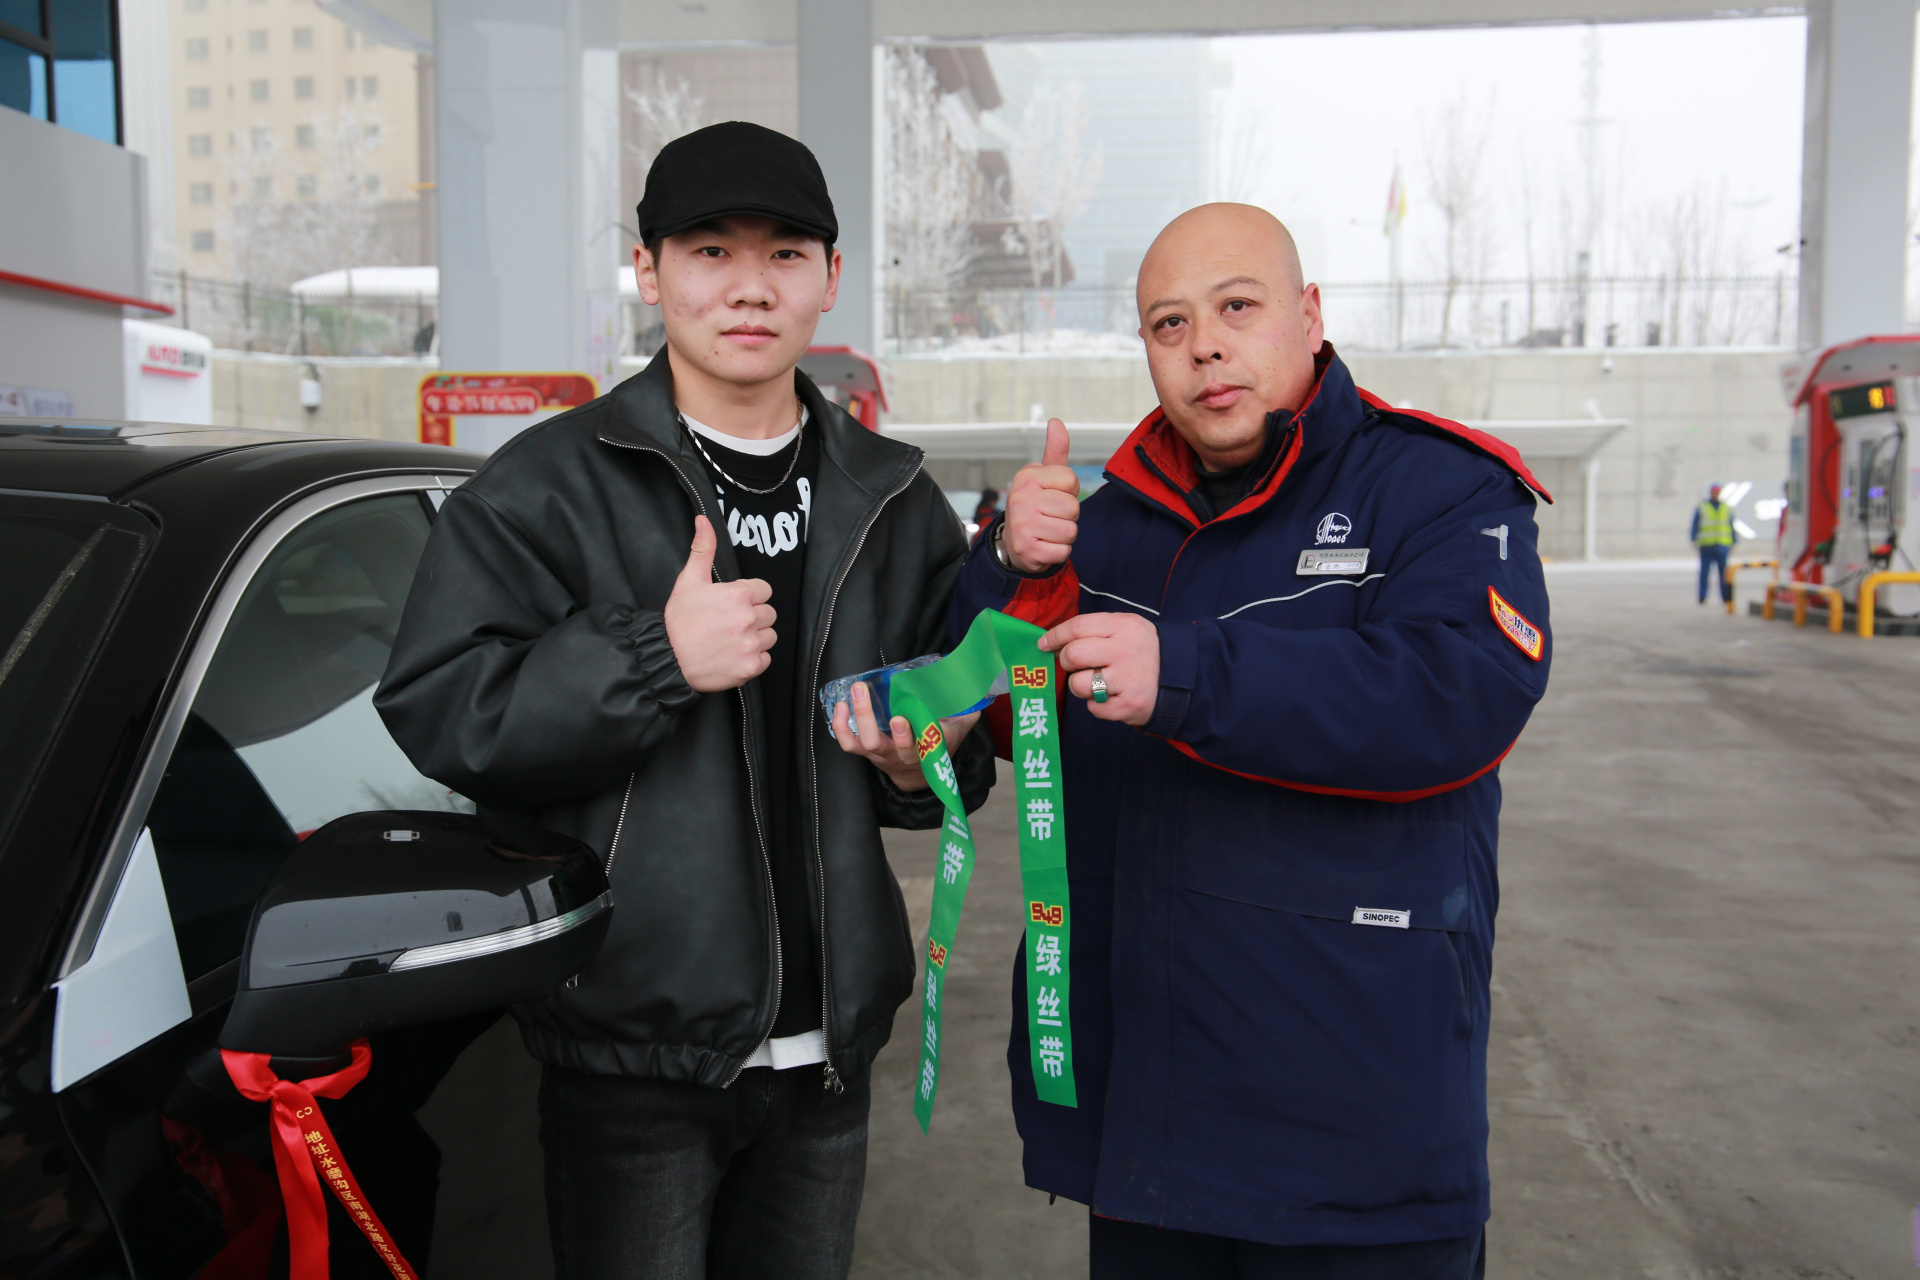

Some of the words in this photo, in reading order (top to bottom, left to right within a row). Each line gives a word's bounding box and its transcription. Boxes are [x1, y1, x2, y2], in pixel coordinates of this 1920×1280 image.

[1019, 698, 1055, 840] 绿丝带
[1363, 912, 1400, 923] SINOPEC
[1036, 934, 1065, 1078] 绿丝带
